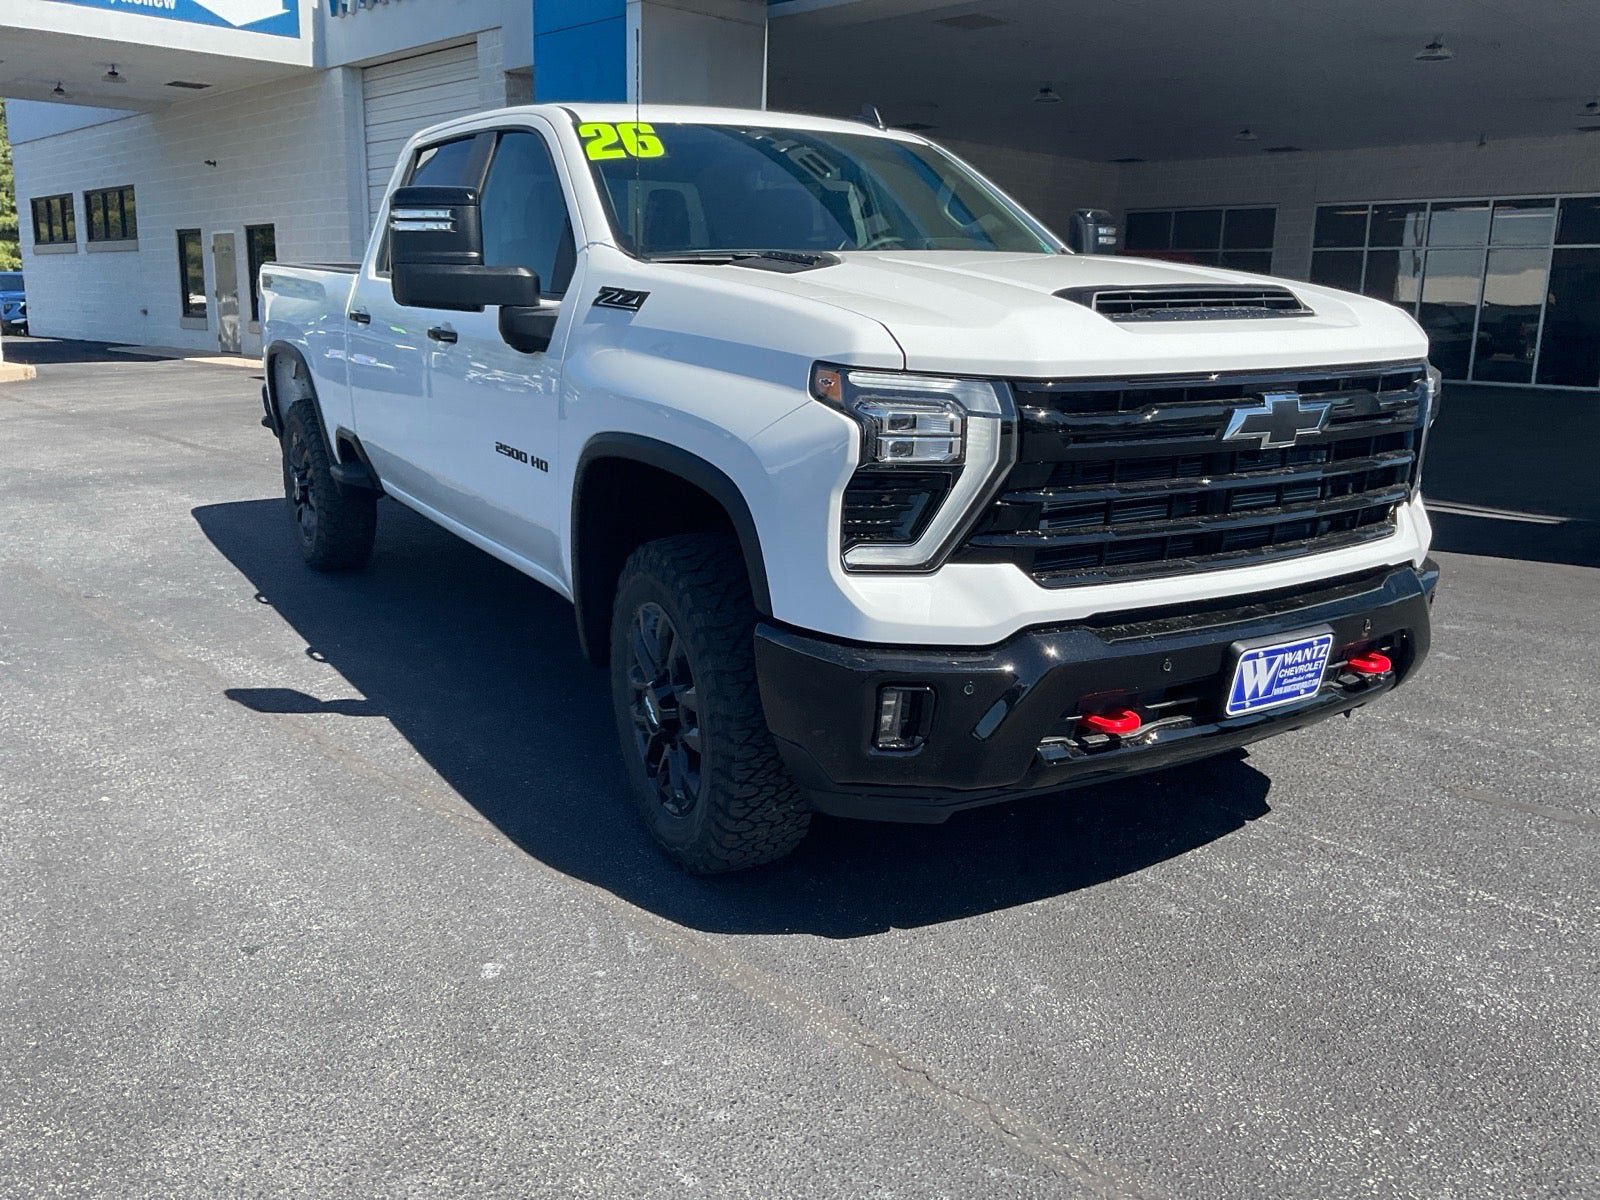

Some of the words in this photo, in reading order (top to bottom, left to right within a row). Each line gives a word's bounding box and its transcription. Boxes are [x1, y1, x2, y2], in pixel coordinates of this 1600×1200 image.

[578, 123, 665, 160] 26
[495, 441, 528, 464] 2500
[531, 455, 549, 473] HD
[1284, 643, 1329, 666] WANTZ
[1278, 660, 1325, 678] CHEVROLET
